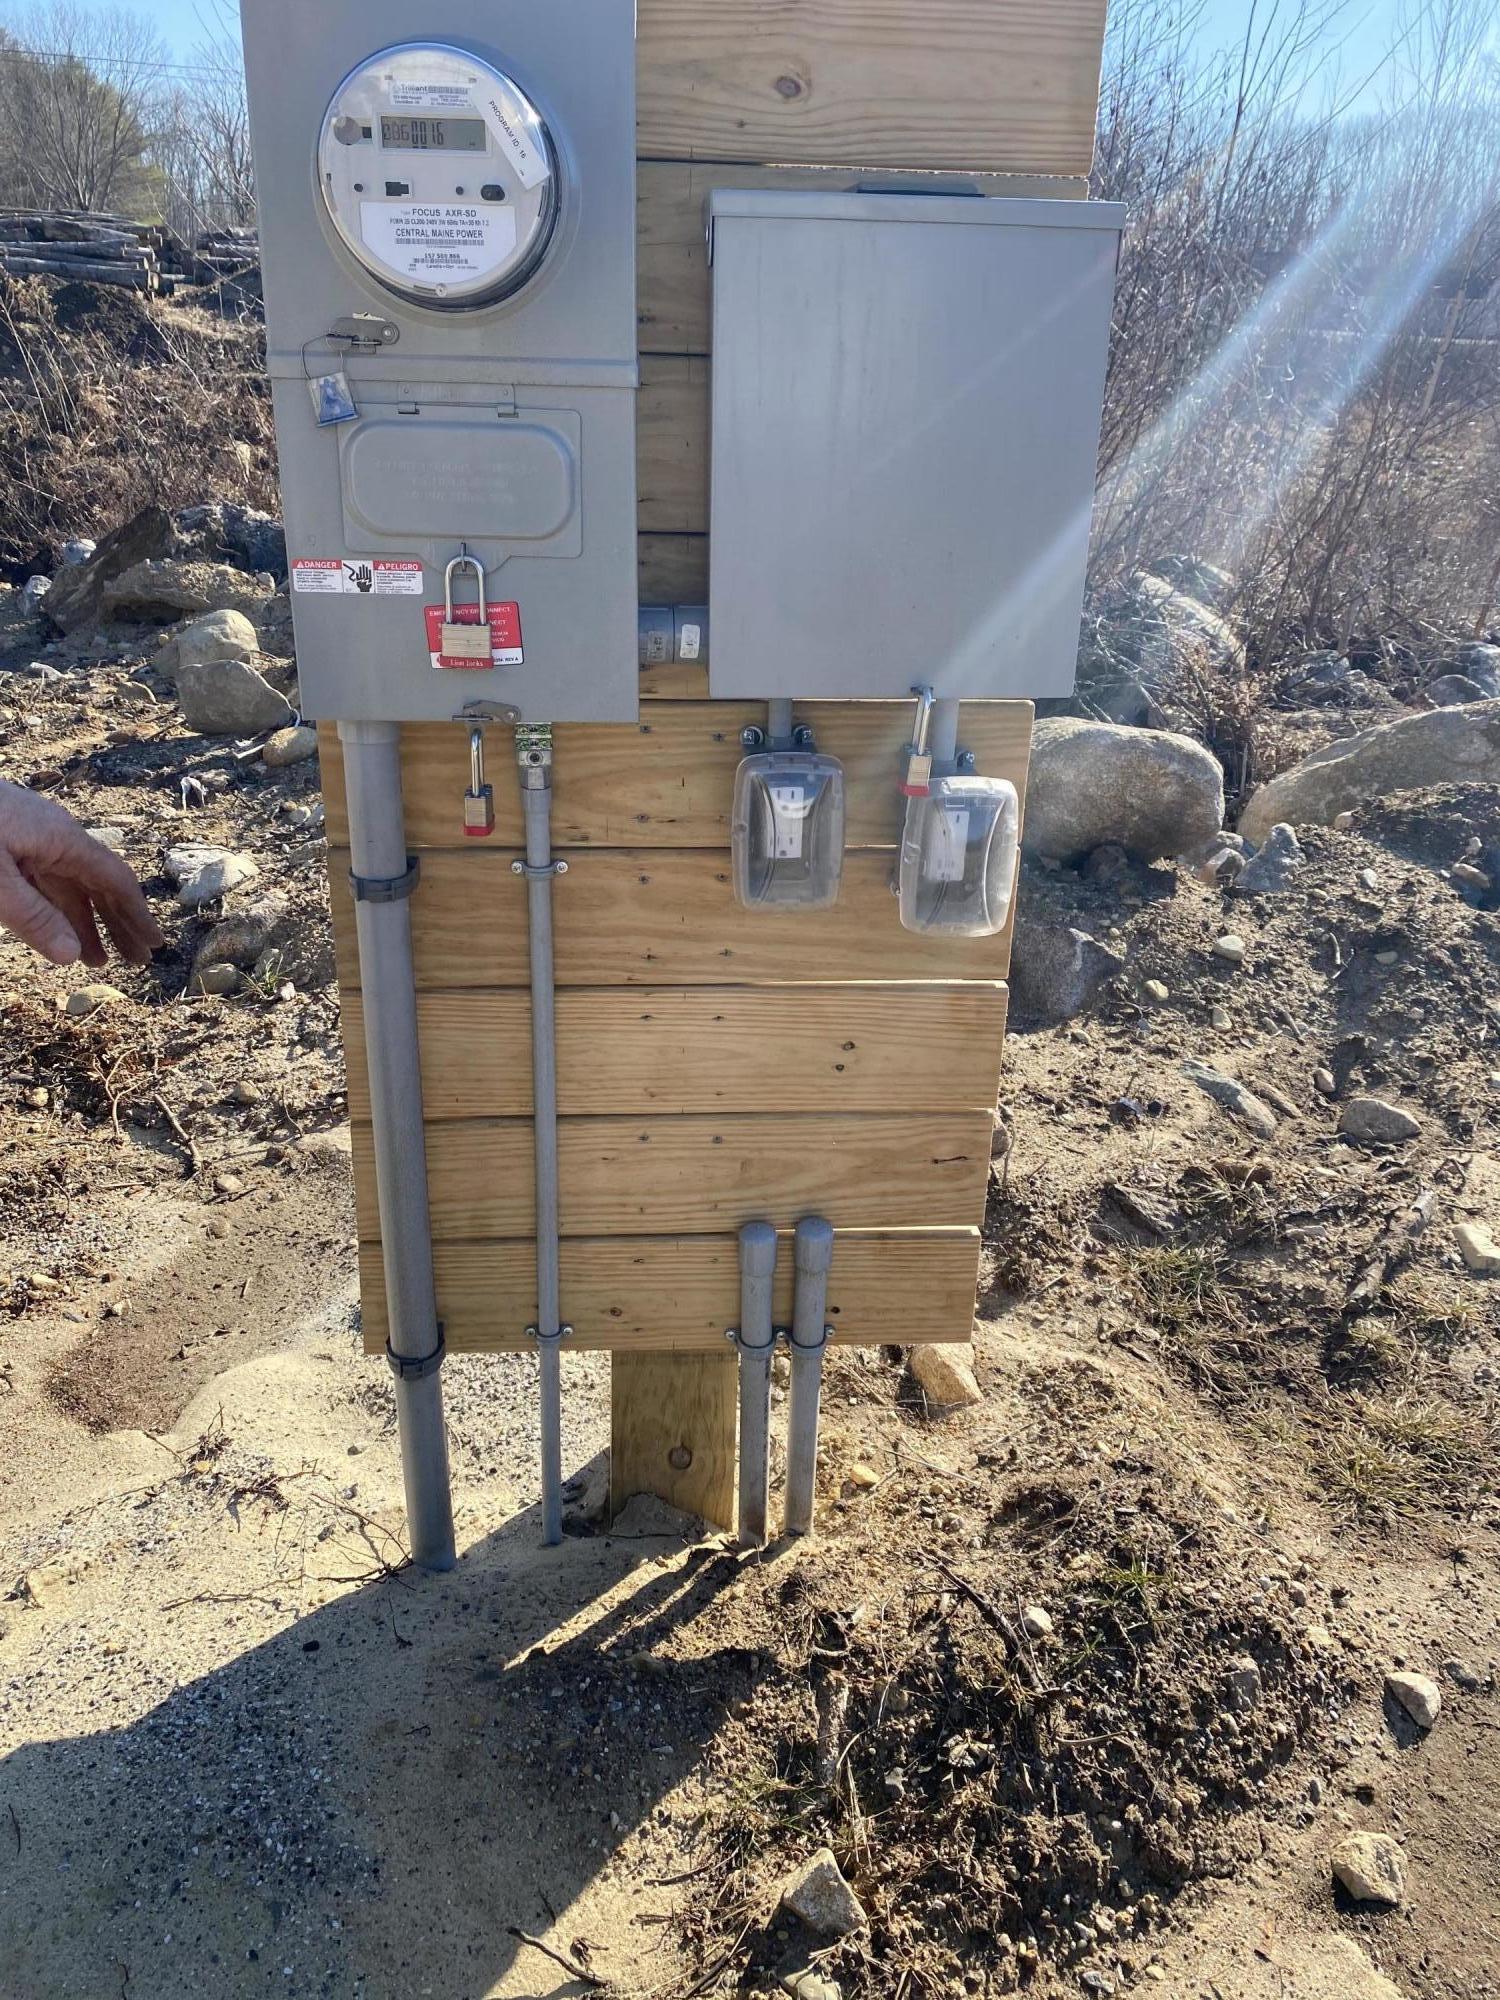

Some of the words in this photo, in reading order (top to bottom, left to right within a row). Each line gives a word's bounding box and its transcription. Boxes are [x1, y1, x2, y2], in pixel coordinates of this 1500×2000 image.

[488, 100, 515, 138] PROGRAM
[412, 208, 441, 217] FOCUS
[395, 228, 430, 238] CENTRAL
[431, 228, 454, 238] MAINE
[456, 229, 483, 239] POWER
[304, 561, 337, 569] DANGER
[385, 563, 419, 571] PELIGRO
